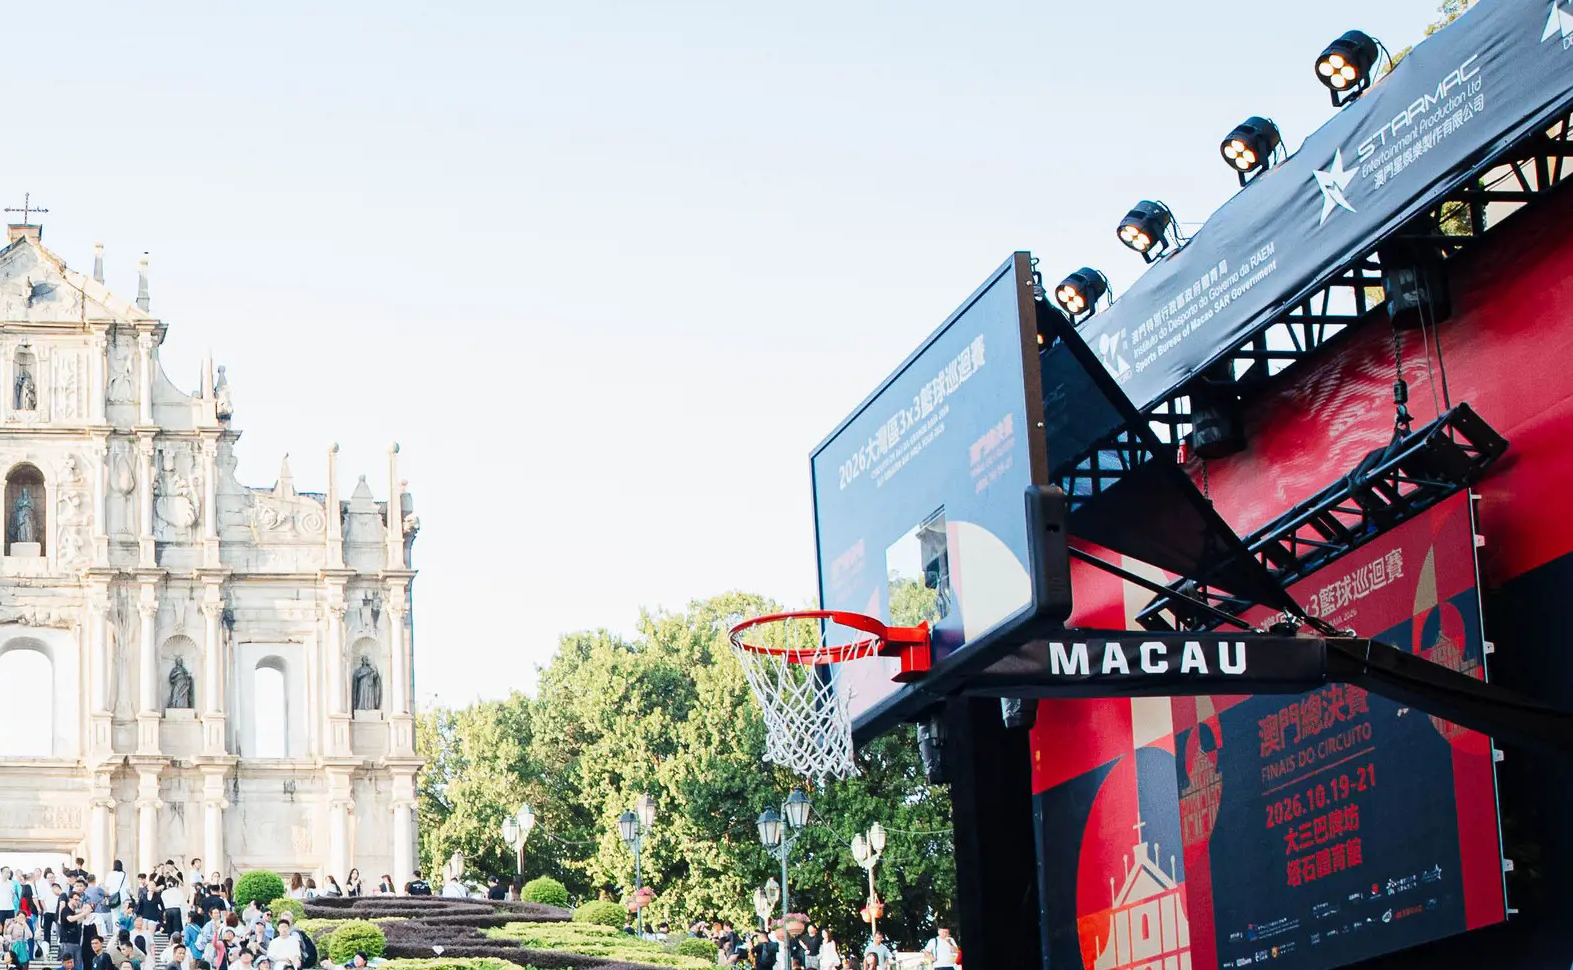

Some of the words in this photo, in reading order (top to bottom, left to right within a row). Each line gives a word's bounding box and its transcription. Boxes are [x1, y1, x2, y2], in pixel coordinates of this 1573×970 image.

[1357, 54, 1481, 162] STARMAC
[1362, 124, 1419, 179] Entertainment
[1419, 91, 1466, 135] Production
[1467, 76, 1482, 102] Ltd
[1133, 333, 1158, 359] Instituto
[1158, 325, 1168, 338] do
[1168, 304, 1198, 334] Desporto
[1198, 295, 1209, 308] do
[1208, 273, 1239, 299] Governo
[1239, 260, 1250, 274] da
[1250, 242, 1275, 270] RAEM
[1135, 350, 1157, 373] Sports
[1157, 332, 1182, 355] Bureau
[1182, 325, 1191, 337] of
[1190, 310, 1214, 332] Macao
[1214, 293, 1230, 313] SAR
[1231, 260, 1277, 299] Government
[1049, 641, 1247, 675] MACAU
[1258, 683, 1370, 757] 澳門總決賽
[1262, 754, 1296, 786] FINAIS
[1297, 747, 1315, 768] DO
[1316, 721, 1373, 760] CIRCUITO
[1266, 763, 1376, 829] 2026.10.19-21
[1284, 803, 1359, 855] 大三巴牌坊
[1287, 837, 1363, 887] 塔石體育館
